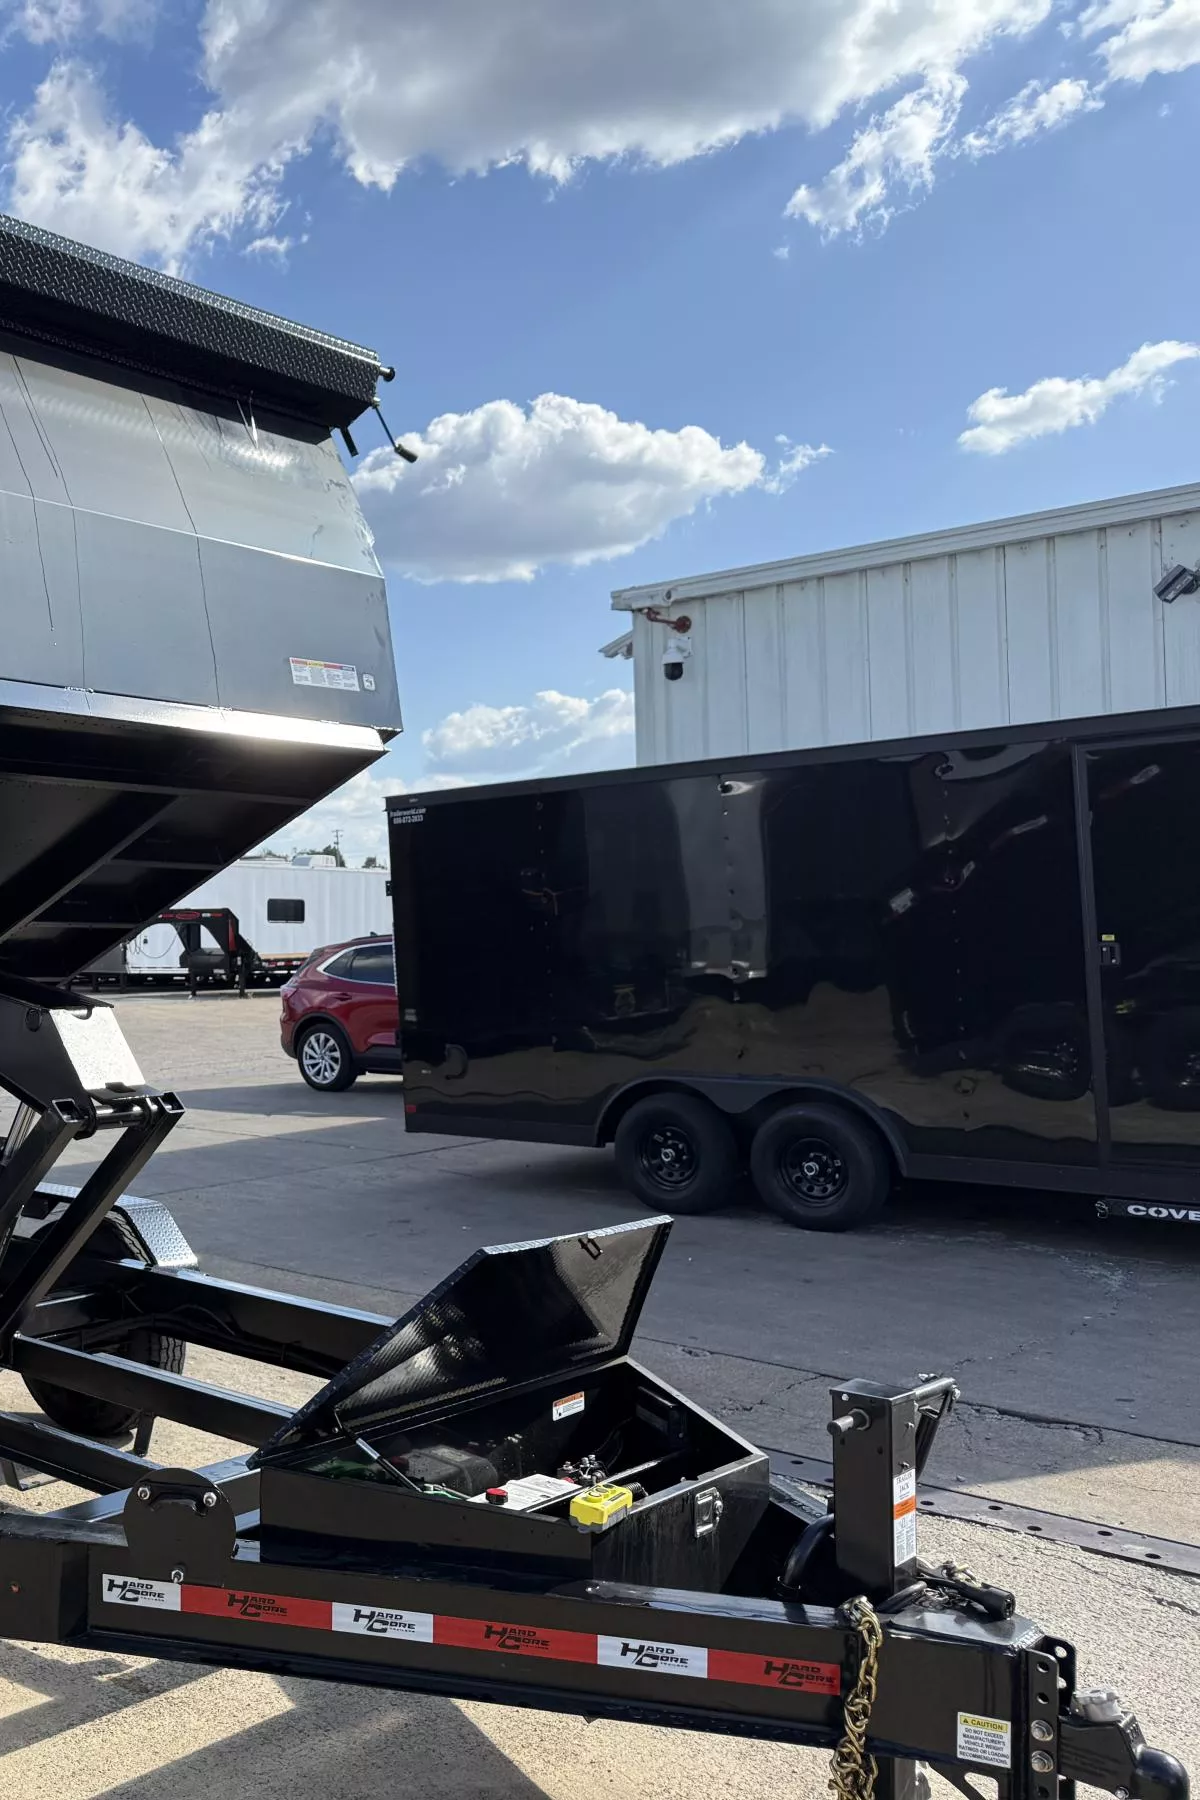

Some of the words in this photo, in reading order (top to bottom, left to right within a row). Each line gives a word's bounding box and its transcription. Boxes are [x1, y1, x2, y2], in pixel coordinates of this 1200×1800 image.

[107, 1578, 154, 1597] HARD
[121, 1588, 165, 1602] CORE
[228, 1593, 276, 1611] HARD
[240, 1604, 288, 1617] CORE
[353, 1608, 403, 1626] HARD
[366, 1619, 416, 1633] CORE
[484, 1625, 537, 1643] HARD
[497, 1635, 550, 1650] CORE
[620, 1642, 675, 1661] HARD
[634, 1653, 689, 1668] CORE
[763, 1660, 821, 1679] HARD
[778, 1671, 836, 1687] CORE
[971, 1719, 1003, 1730] CAUTION
[984, 1731, 1003, 1739] EXCEED
[959, 1745, 979, 1753] RATINGS
[988, 1750, 1009, 1759] LOADING
[964, 1740, 984, 1748] VEHICLE
[985, 1744, 1003, 1752] WEIGHT
